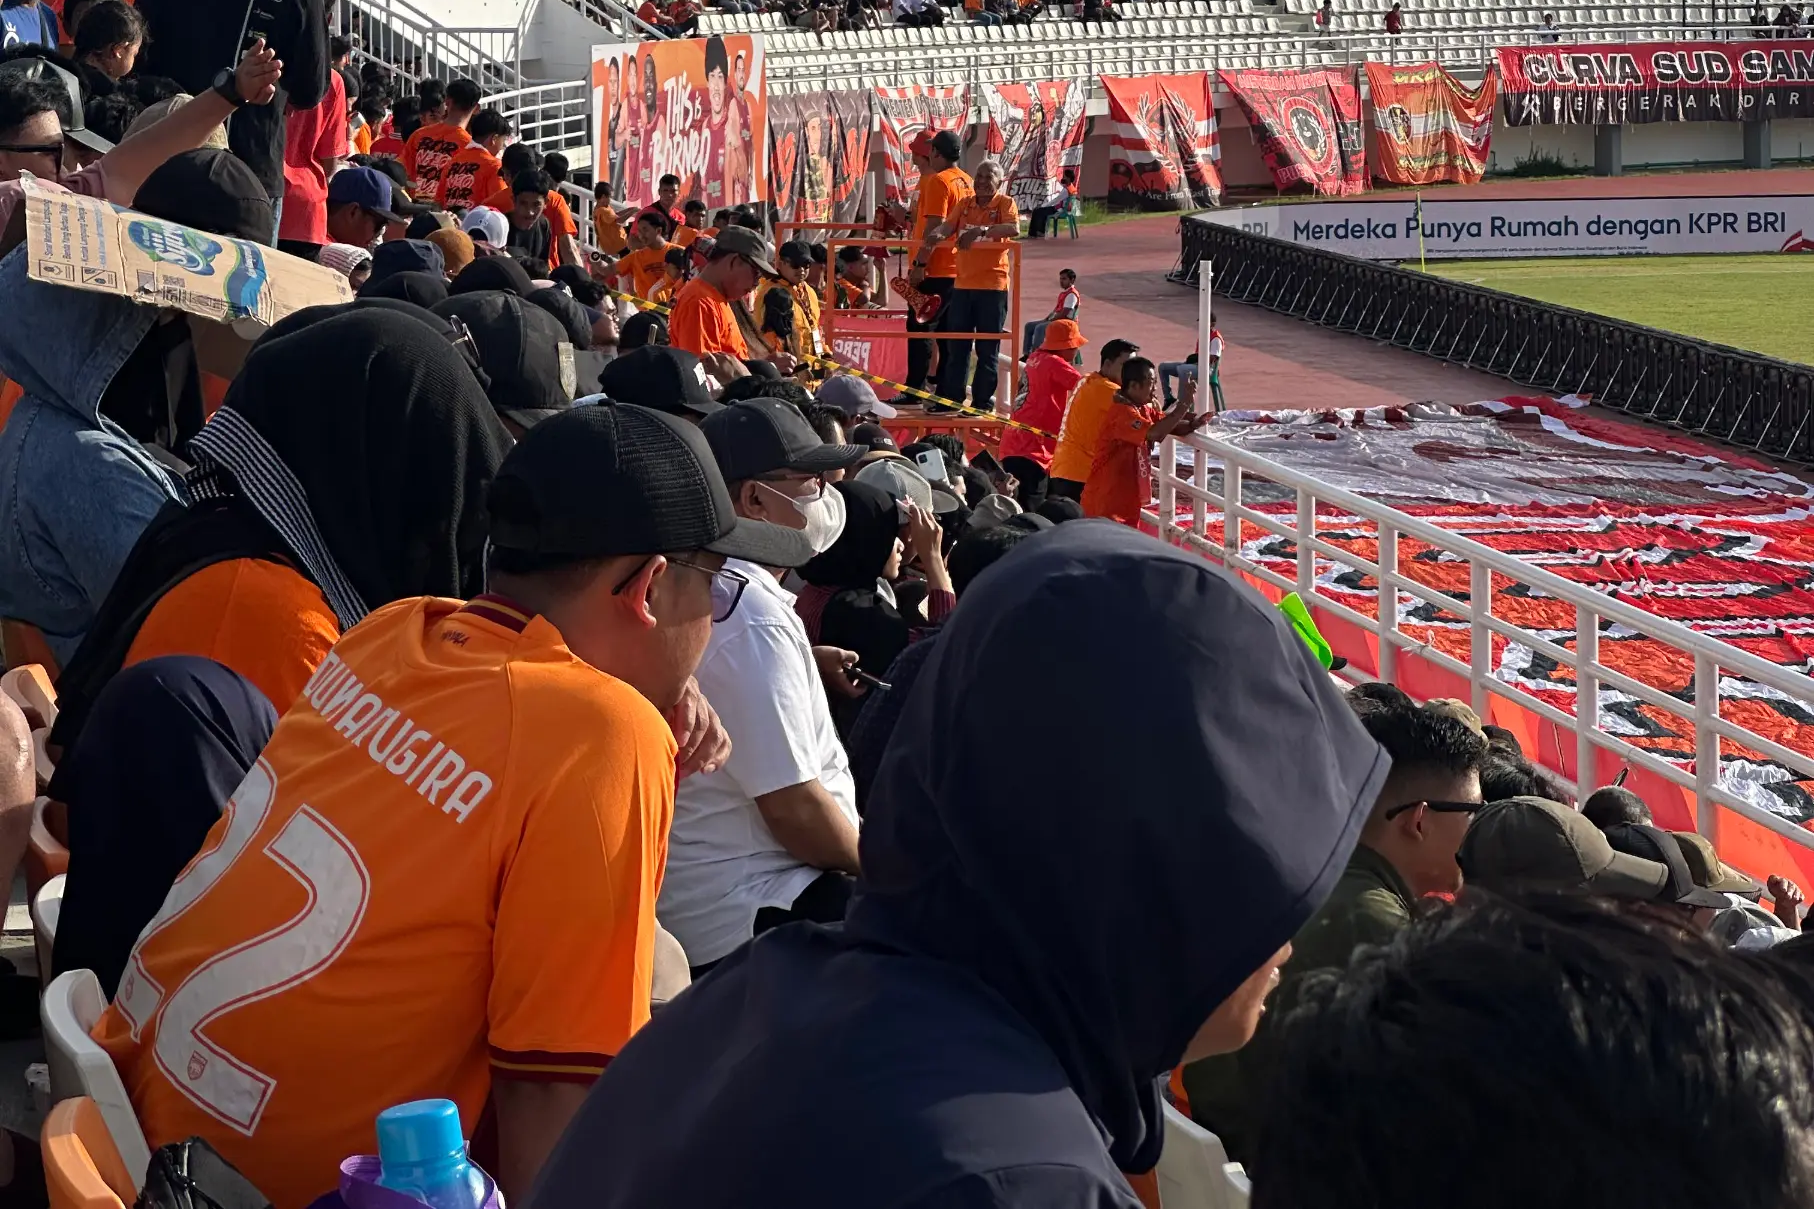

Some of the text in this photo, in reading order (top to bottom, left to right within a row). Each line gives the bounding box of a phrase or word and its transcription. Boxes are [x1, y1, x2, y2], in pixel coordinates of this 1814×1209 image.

[1523, 53, 1644, 87] CURVA
[1652, 51, 1732, 85] SUD
[1553, 94, 1720, 111] BERGERAK
[1293, 218, 1397, 241] Merdeka
[1405, 217, 1482, 243] Punya
[1491, 215, 1579, 237] Rumah
[1586, 214, 1681, 240] dengan
[1688, 212, 1738, 234] KPR
[1747, 211, 1786, 233] BRI
